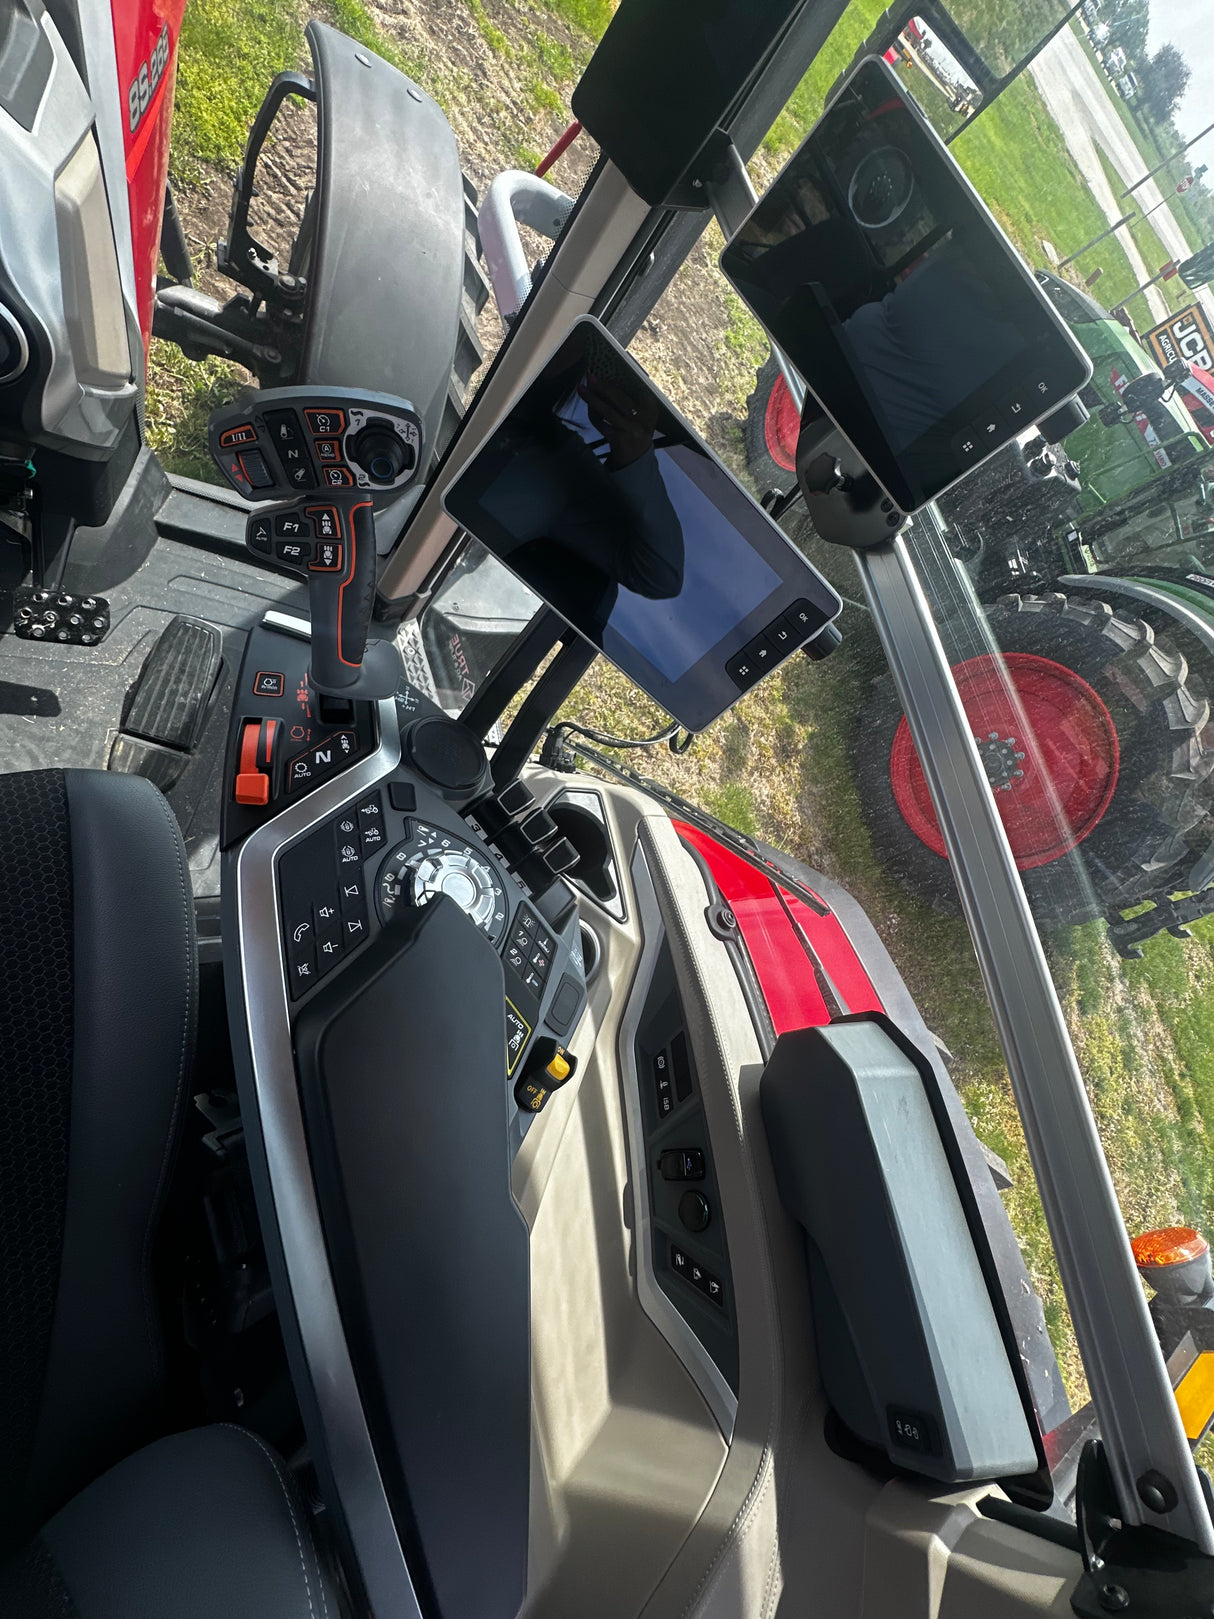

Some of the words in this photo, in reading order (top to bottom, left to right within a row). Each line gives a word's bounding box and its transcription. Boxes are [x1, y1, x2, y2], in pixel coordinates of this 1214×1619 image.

[129, 22, 170, 134] 8S.265
[1159, 334, 1177, 365] AGRICU
[1172, 321, 1213, 370] JCB
[1038, 382, 1048, 394] OK
[1195, 387, 1214, 410] MASSE
[288, 449, 299, 459] N
[283, 522, 300, 533] F1
[283, 545, 301, 556] F2
[799, 612, 809, 623] OK
[315, 750, 331, 764] N
[294, 771, 312, 779] AUTO
[472, 823, 481, 832] 3
[365, 835, 381, 844] AUTO
[441, 839, 451, 848] 6
[463, 847, 473, 855] 5
[341, 854, 359, 863] AUTO
[494, 852, 503, 861] 4
[517, 880, 527, 889] 5
[494, 887, 502, 896] 3
[495, 912, 505, 921] 2
[510, 948, 518, 956] 2
[507, 1013, 524, 1030] AUTO
[557, 1046, 566, 1055] ON
[526, 1084, 539, 1095] OFF
